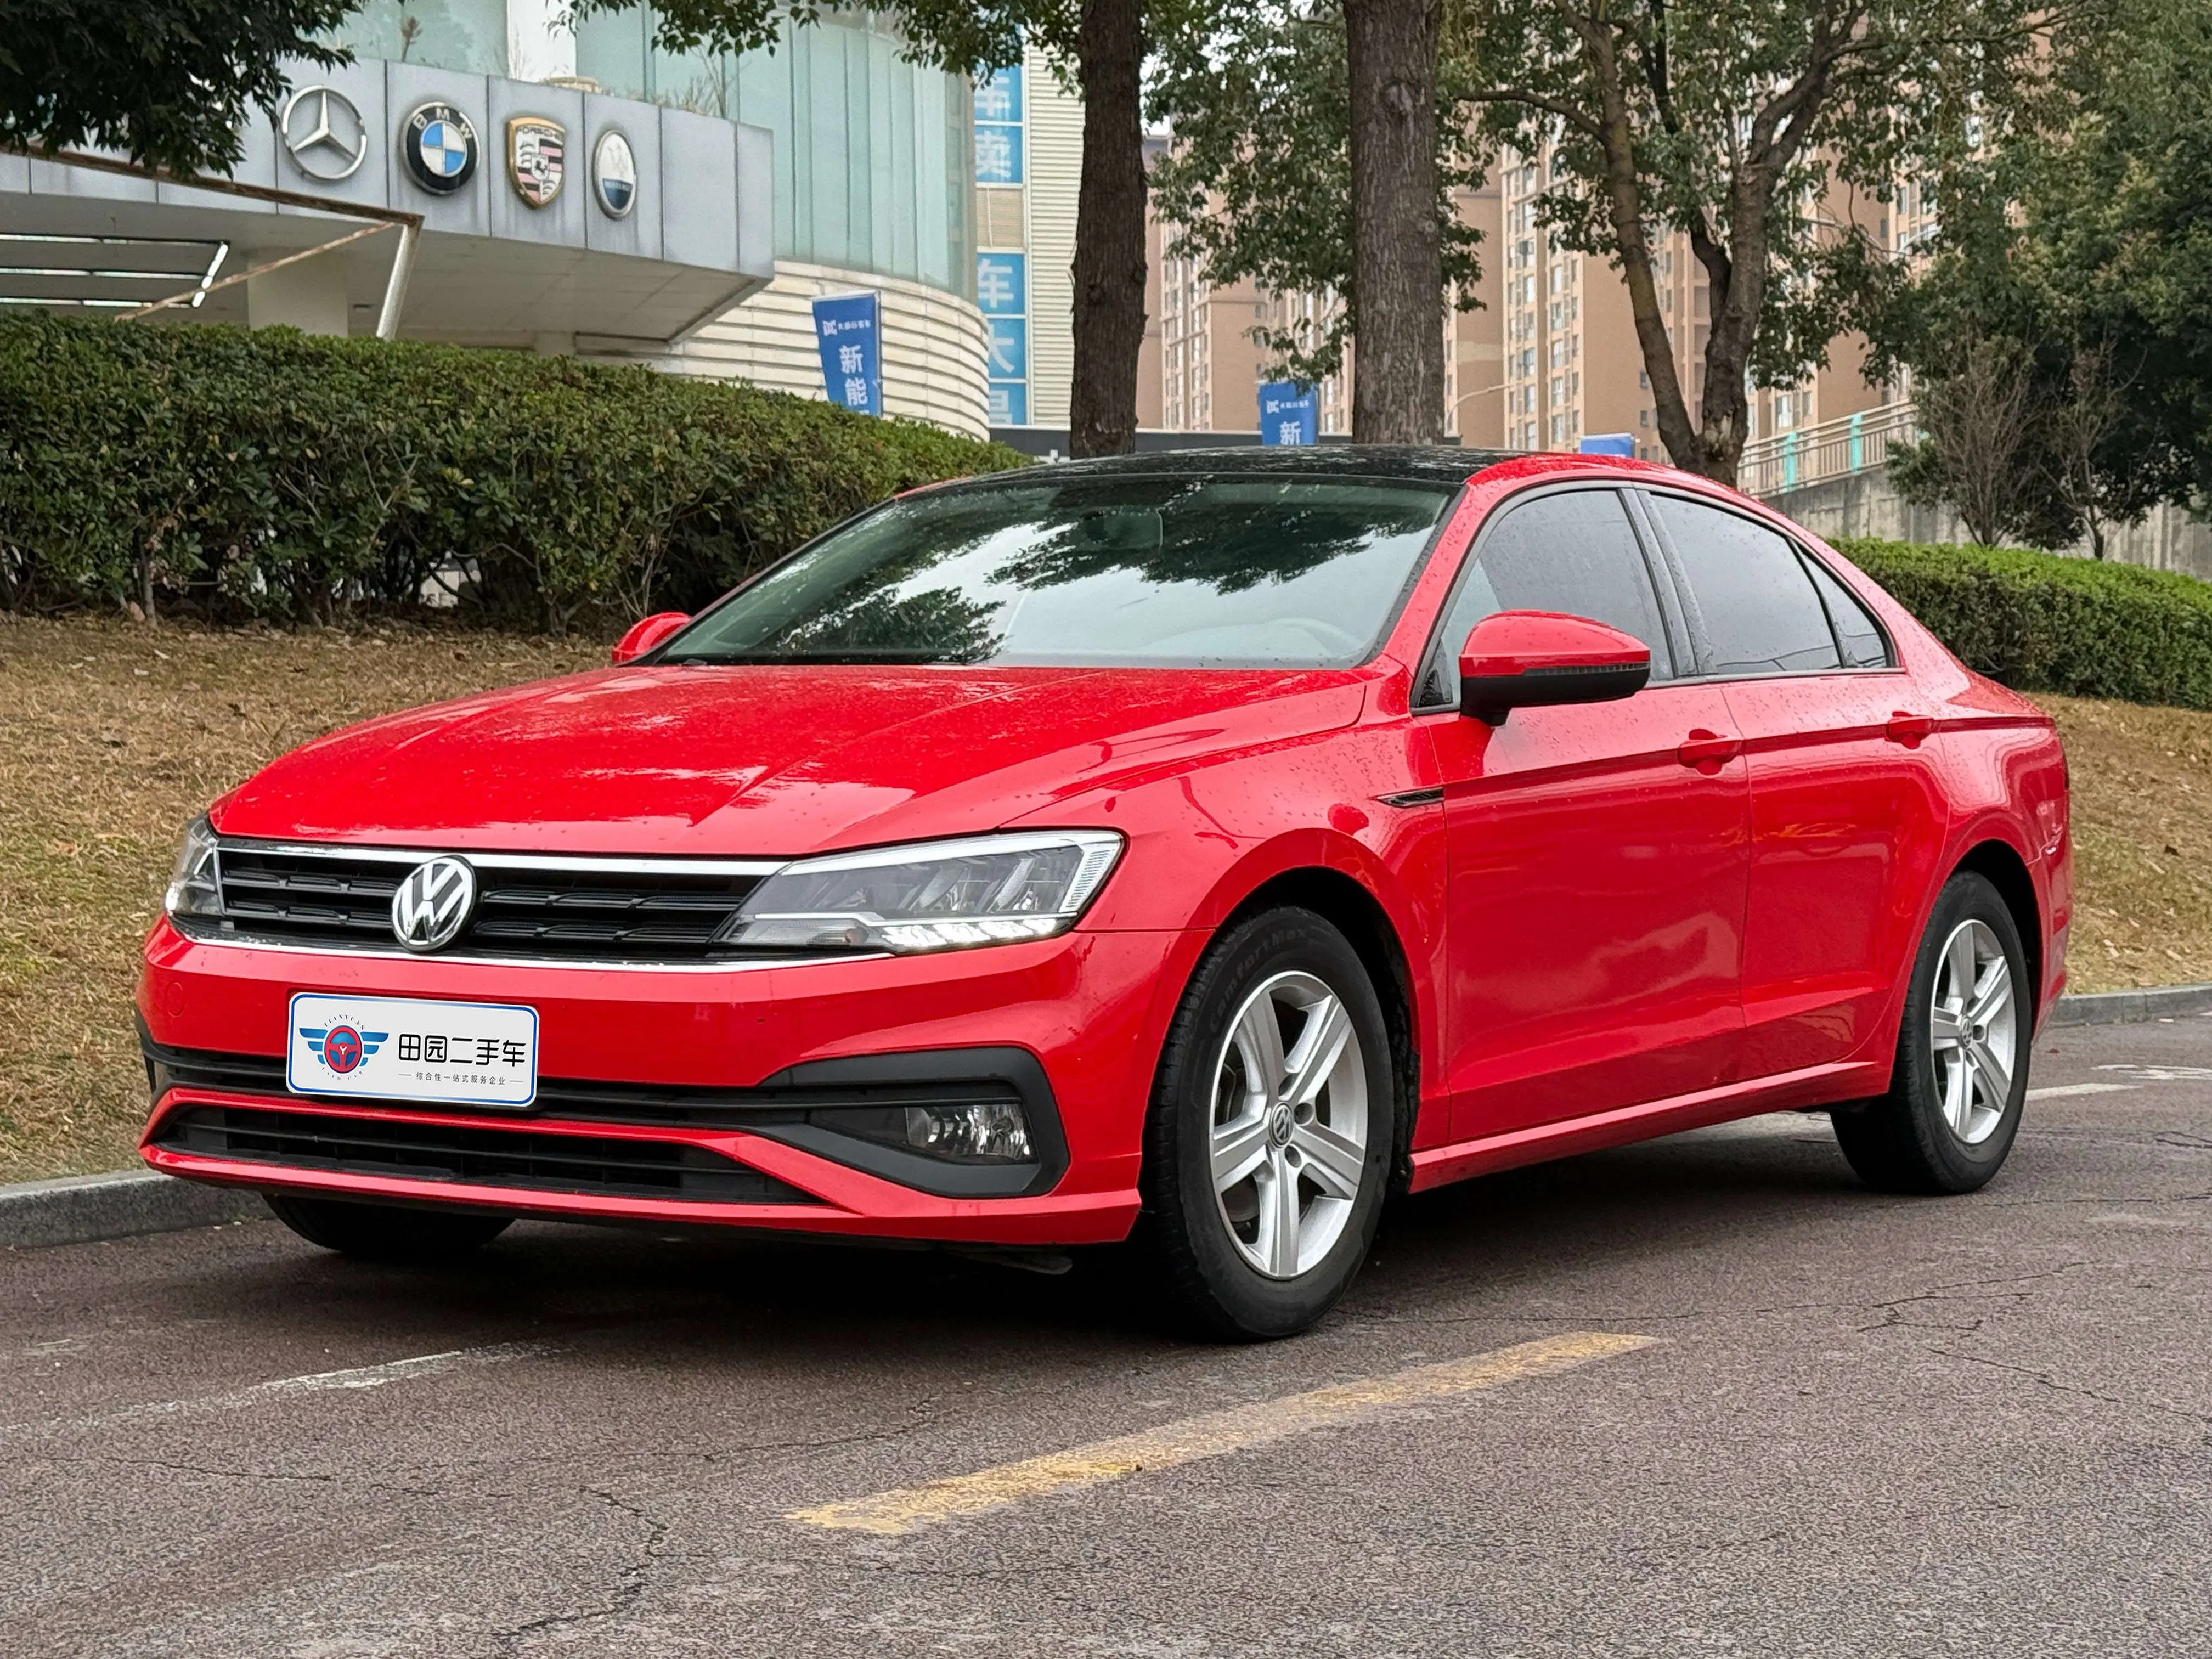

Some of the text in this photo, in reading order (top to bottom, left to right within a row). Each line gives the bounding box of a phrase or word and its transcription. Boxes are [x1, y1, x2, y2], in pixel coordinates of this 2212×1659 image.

[413, 107, 472, 138] BMW
[839, 344, 870, 415] 新能
[1280, 421, 1302, 445] 新
[398, 1033, 526, 1068] 田园二手车
[416, 1071, 505, 1085] 综合性一站式服务企业
